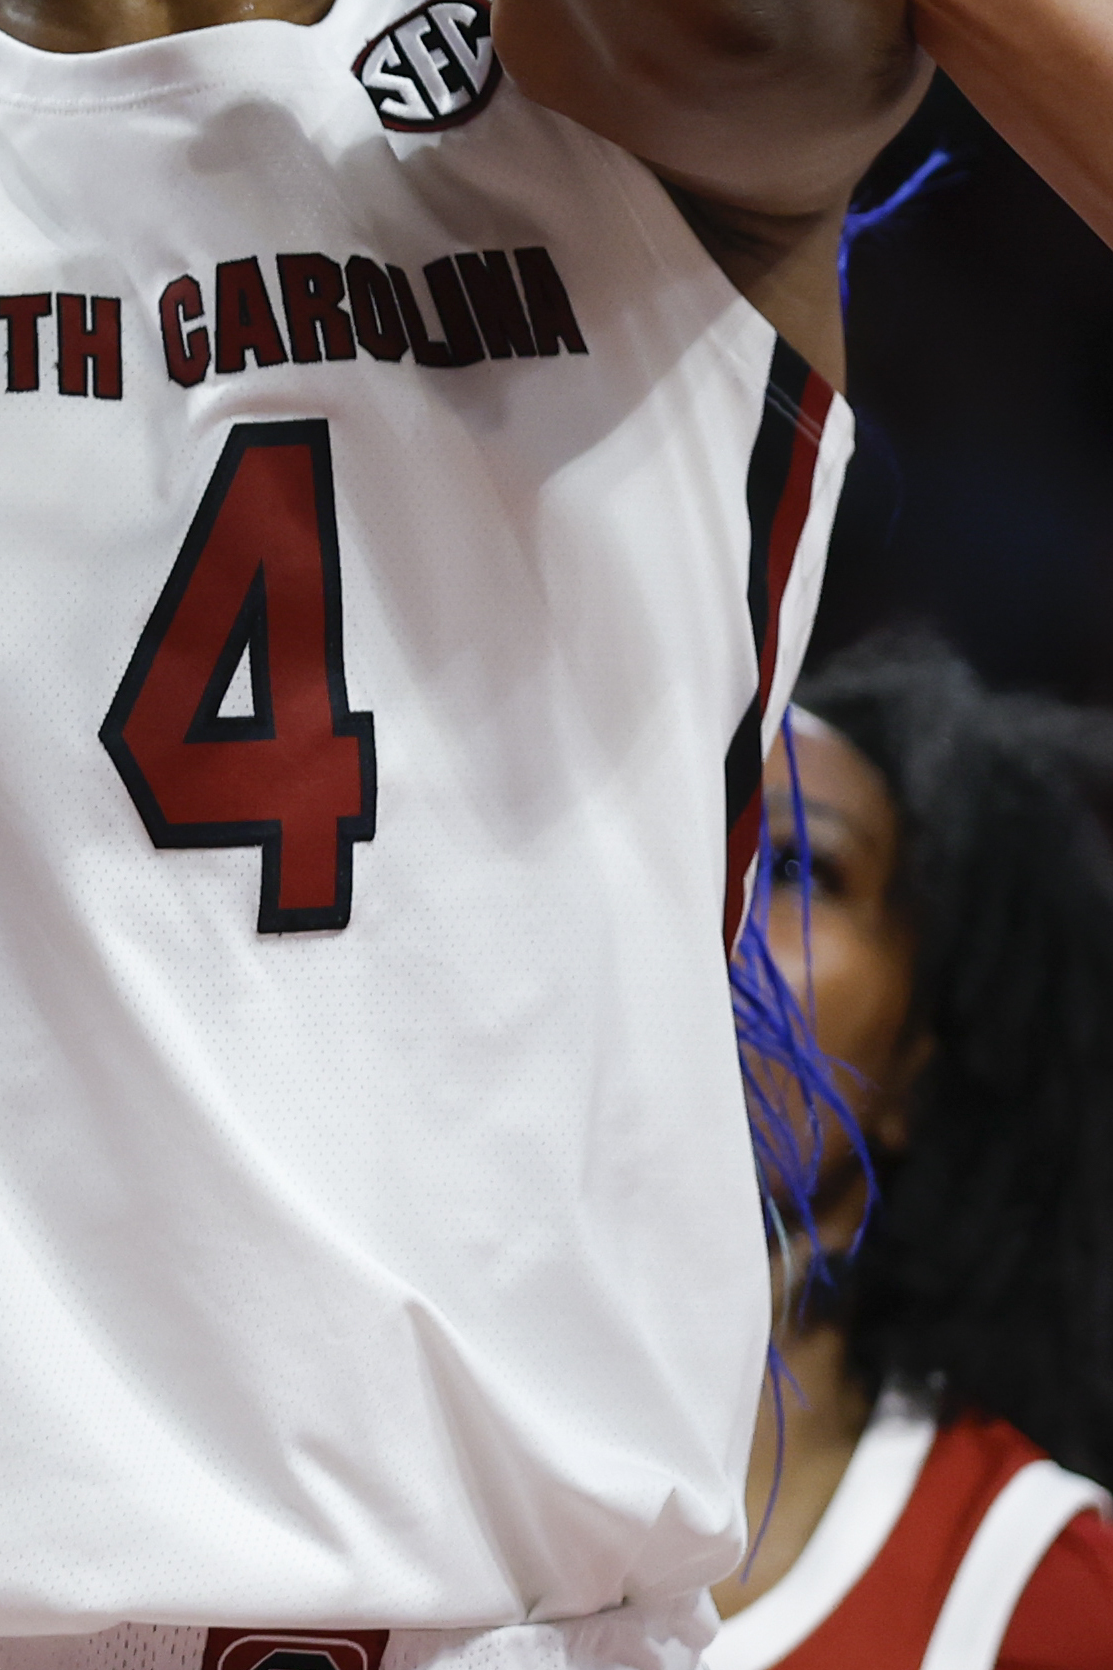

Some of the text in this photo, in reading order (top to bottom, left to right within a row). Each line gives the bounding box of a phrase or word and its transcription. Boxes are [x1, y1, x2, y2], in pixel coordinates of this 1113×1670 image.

[361, 2, 494, 120] SEC
[159, 246, 589, 388] CAROLINA
[98, 418, 378, 933] 4
